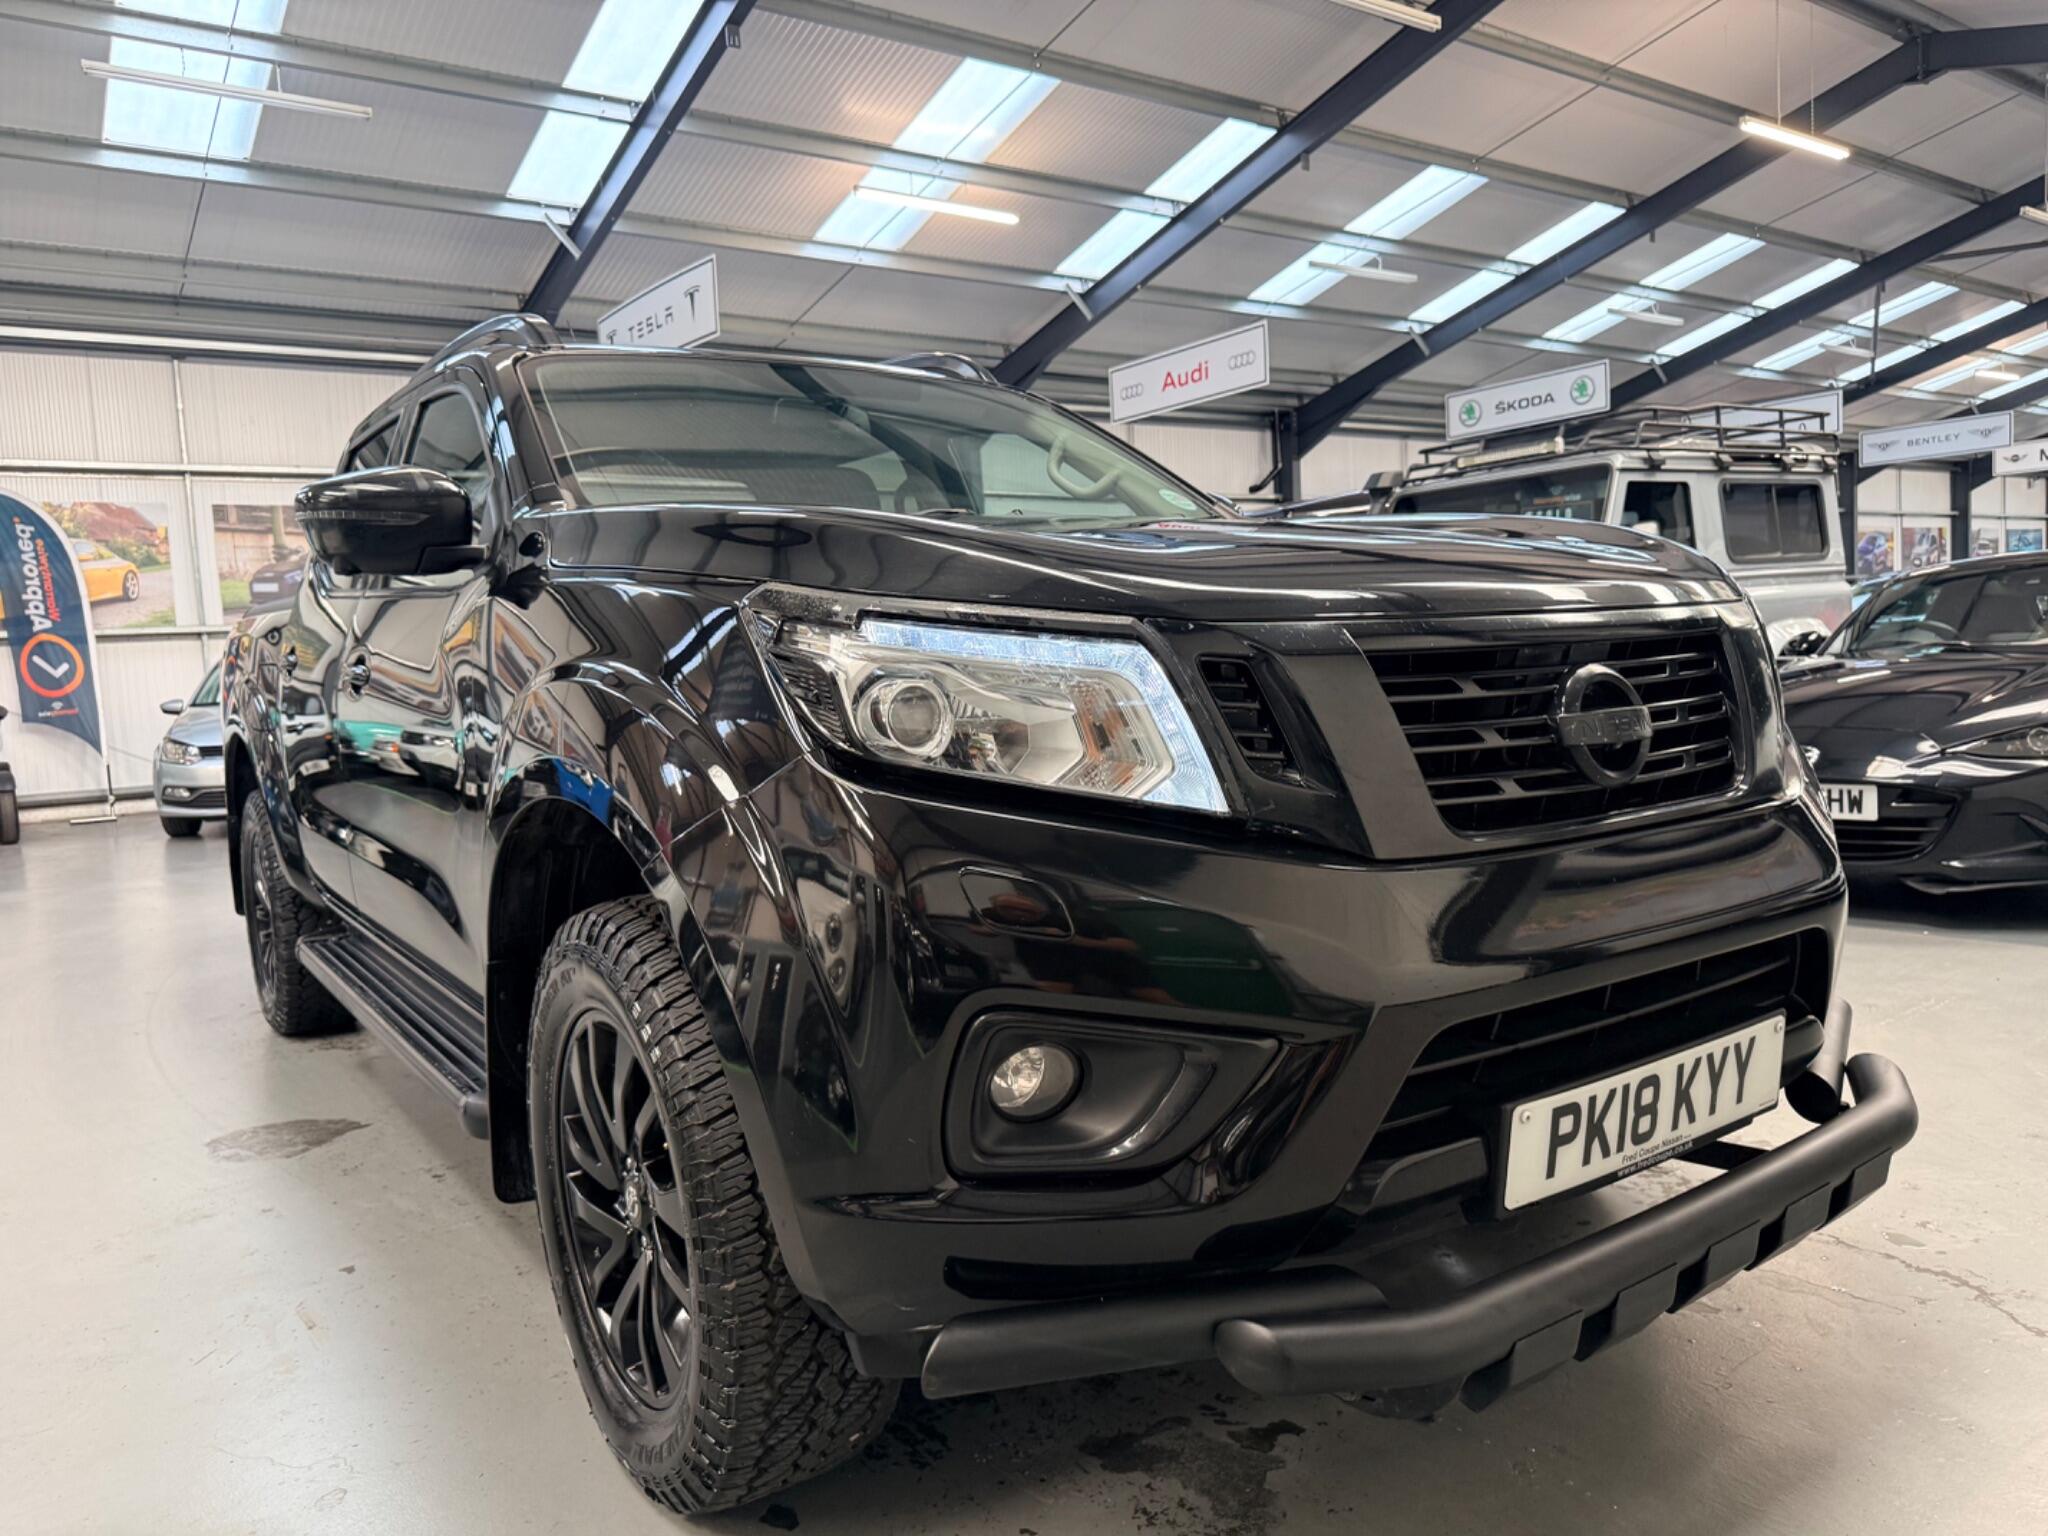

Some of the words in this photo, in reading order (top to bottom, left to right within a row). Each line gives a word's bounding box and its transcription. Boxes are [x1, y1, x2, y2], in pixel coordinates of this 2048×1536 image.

[627, 305, 674, 343] TESLA
[1161, 360, 1210, 393] Audi
[1906, 432, 1961, 447] BENTLEY
[1545, 1073, 1661, 1180] PK18
[1671, 1036, 1756, 1132] KYY
